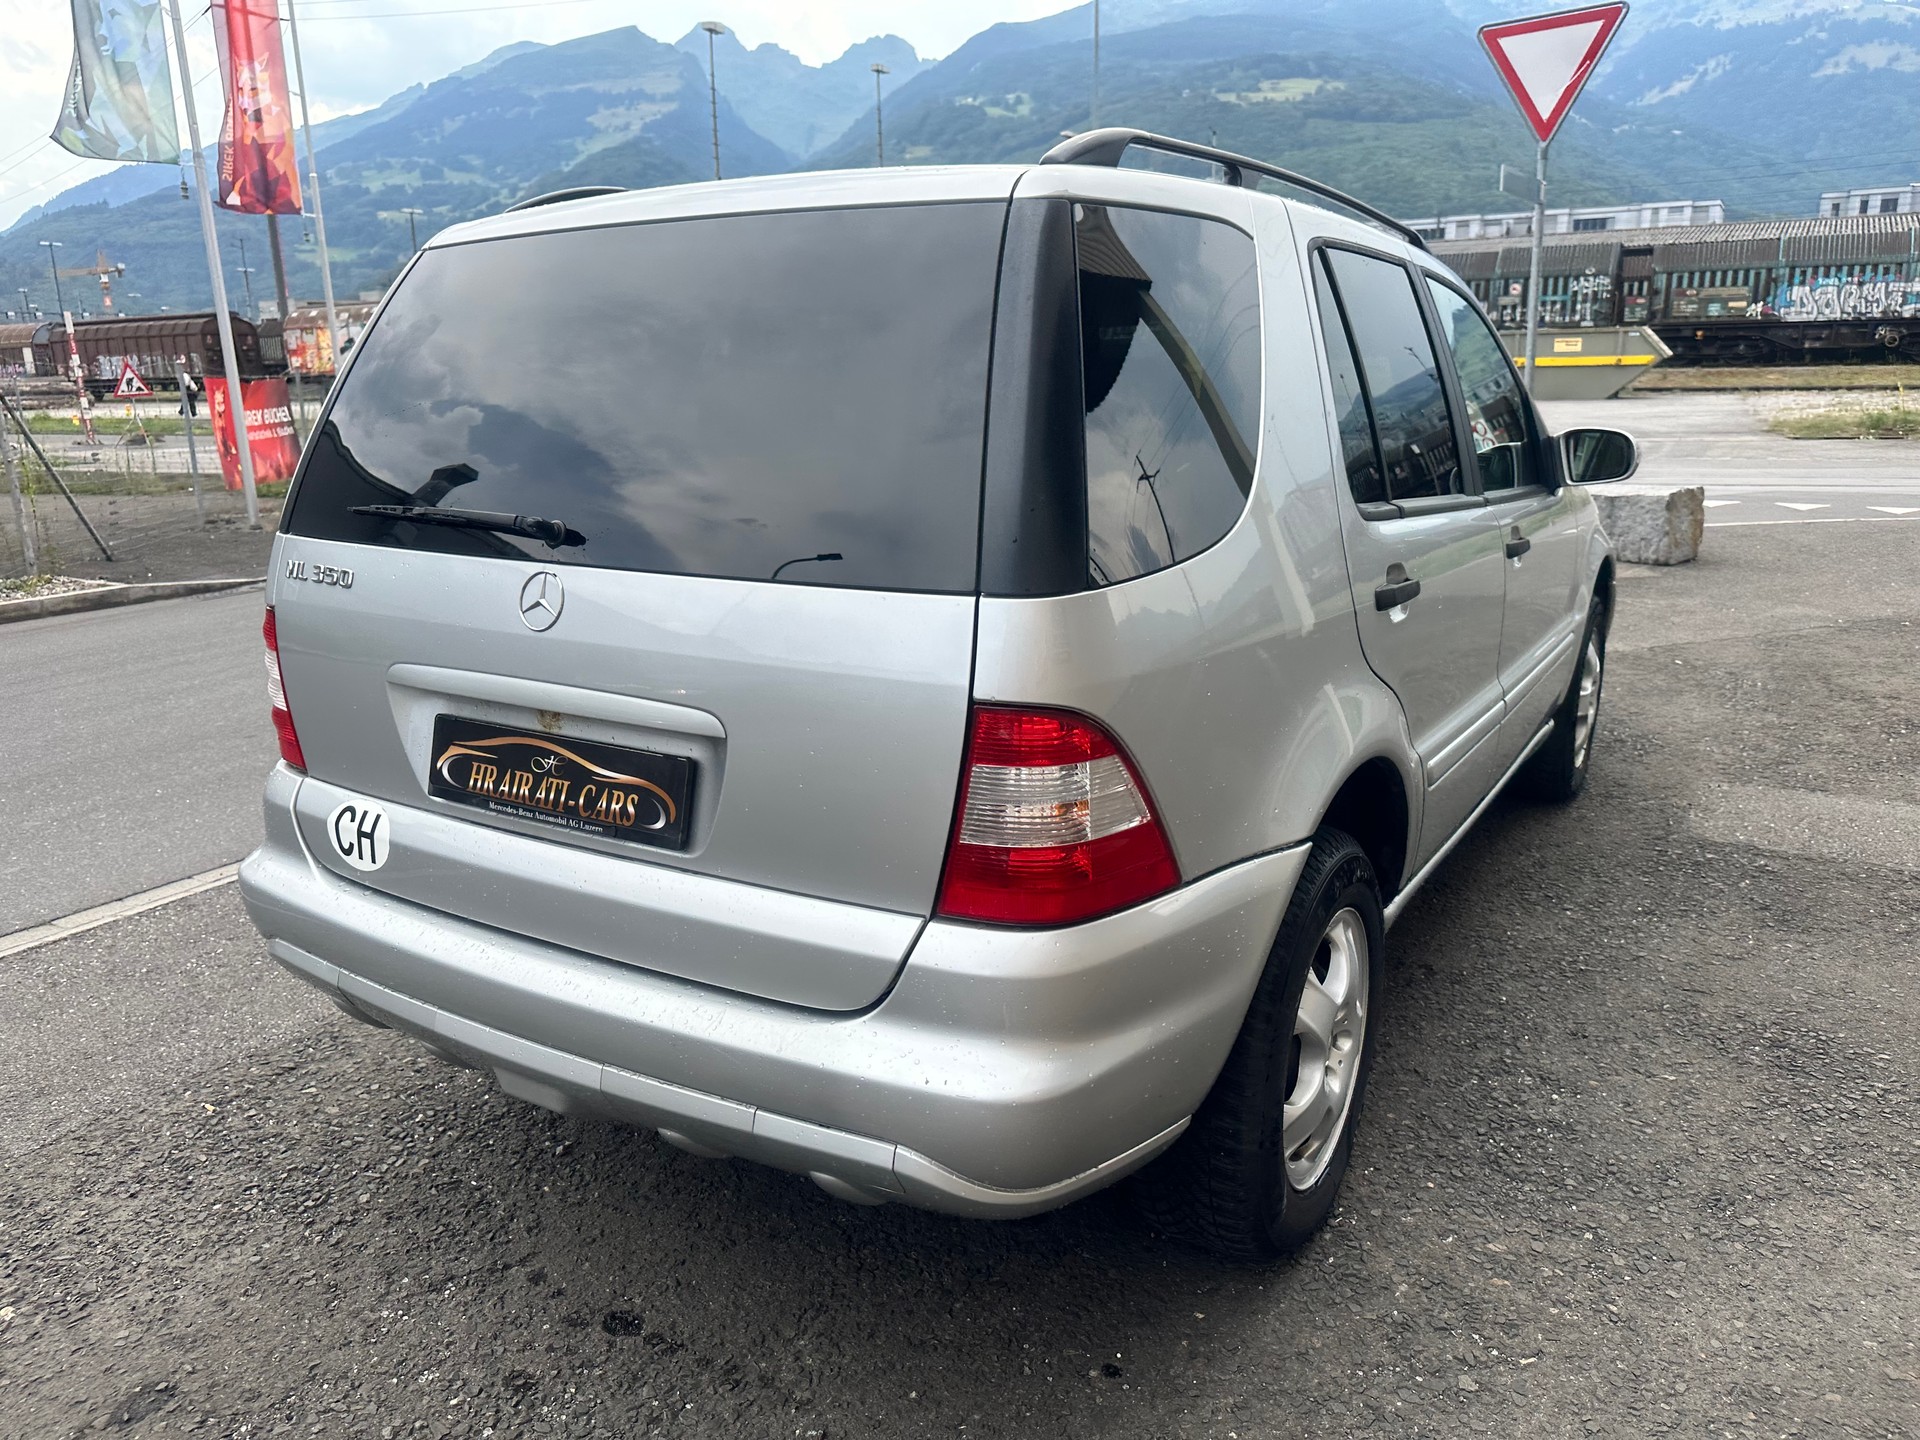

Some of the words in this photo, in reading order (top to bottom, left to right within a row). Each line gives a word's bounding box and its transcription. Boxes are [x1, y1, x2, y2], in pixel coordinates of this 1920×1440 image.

[311, 563, 355, 590] 350
[488, 801, 534, 818] Mercedes-Benz
[534, 811, 567, 826] Automobil
[567, 819, 579, 828] AG
[580, 821, 603, 833] Luzern
[335, 805, 381, 865] CH
